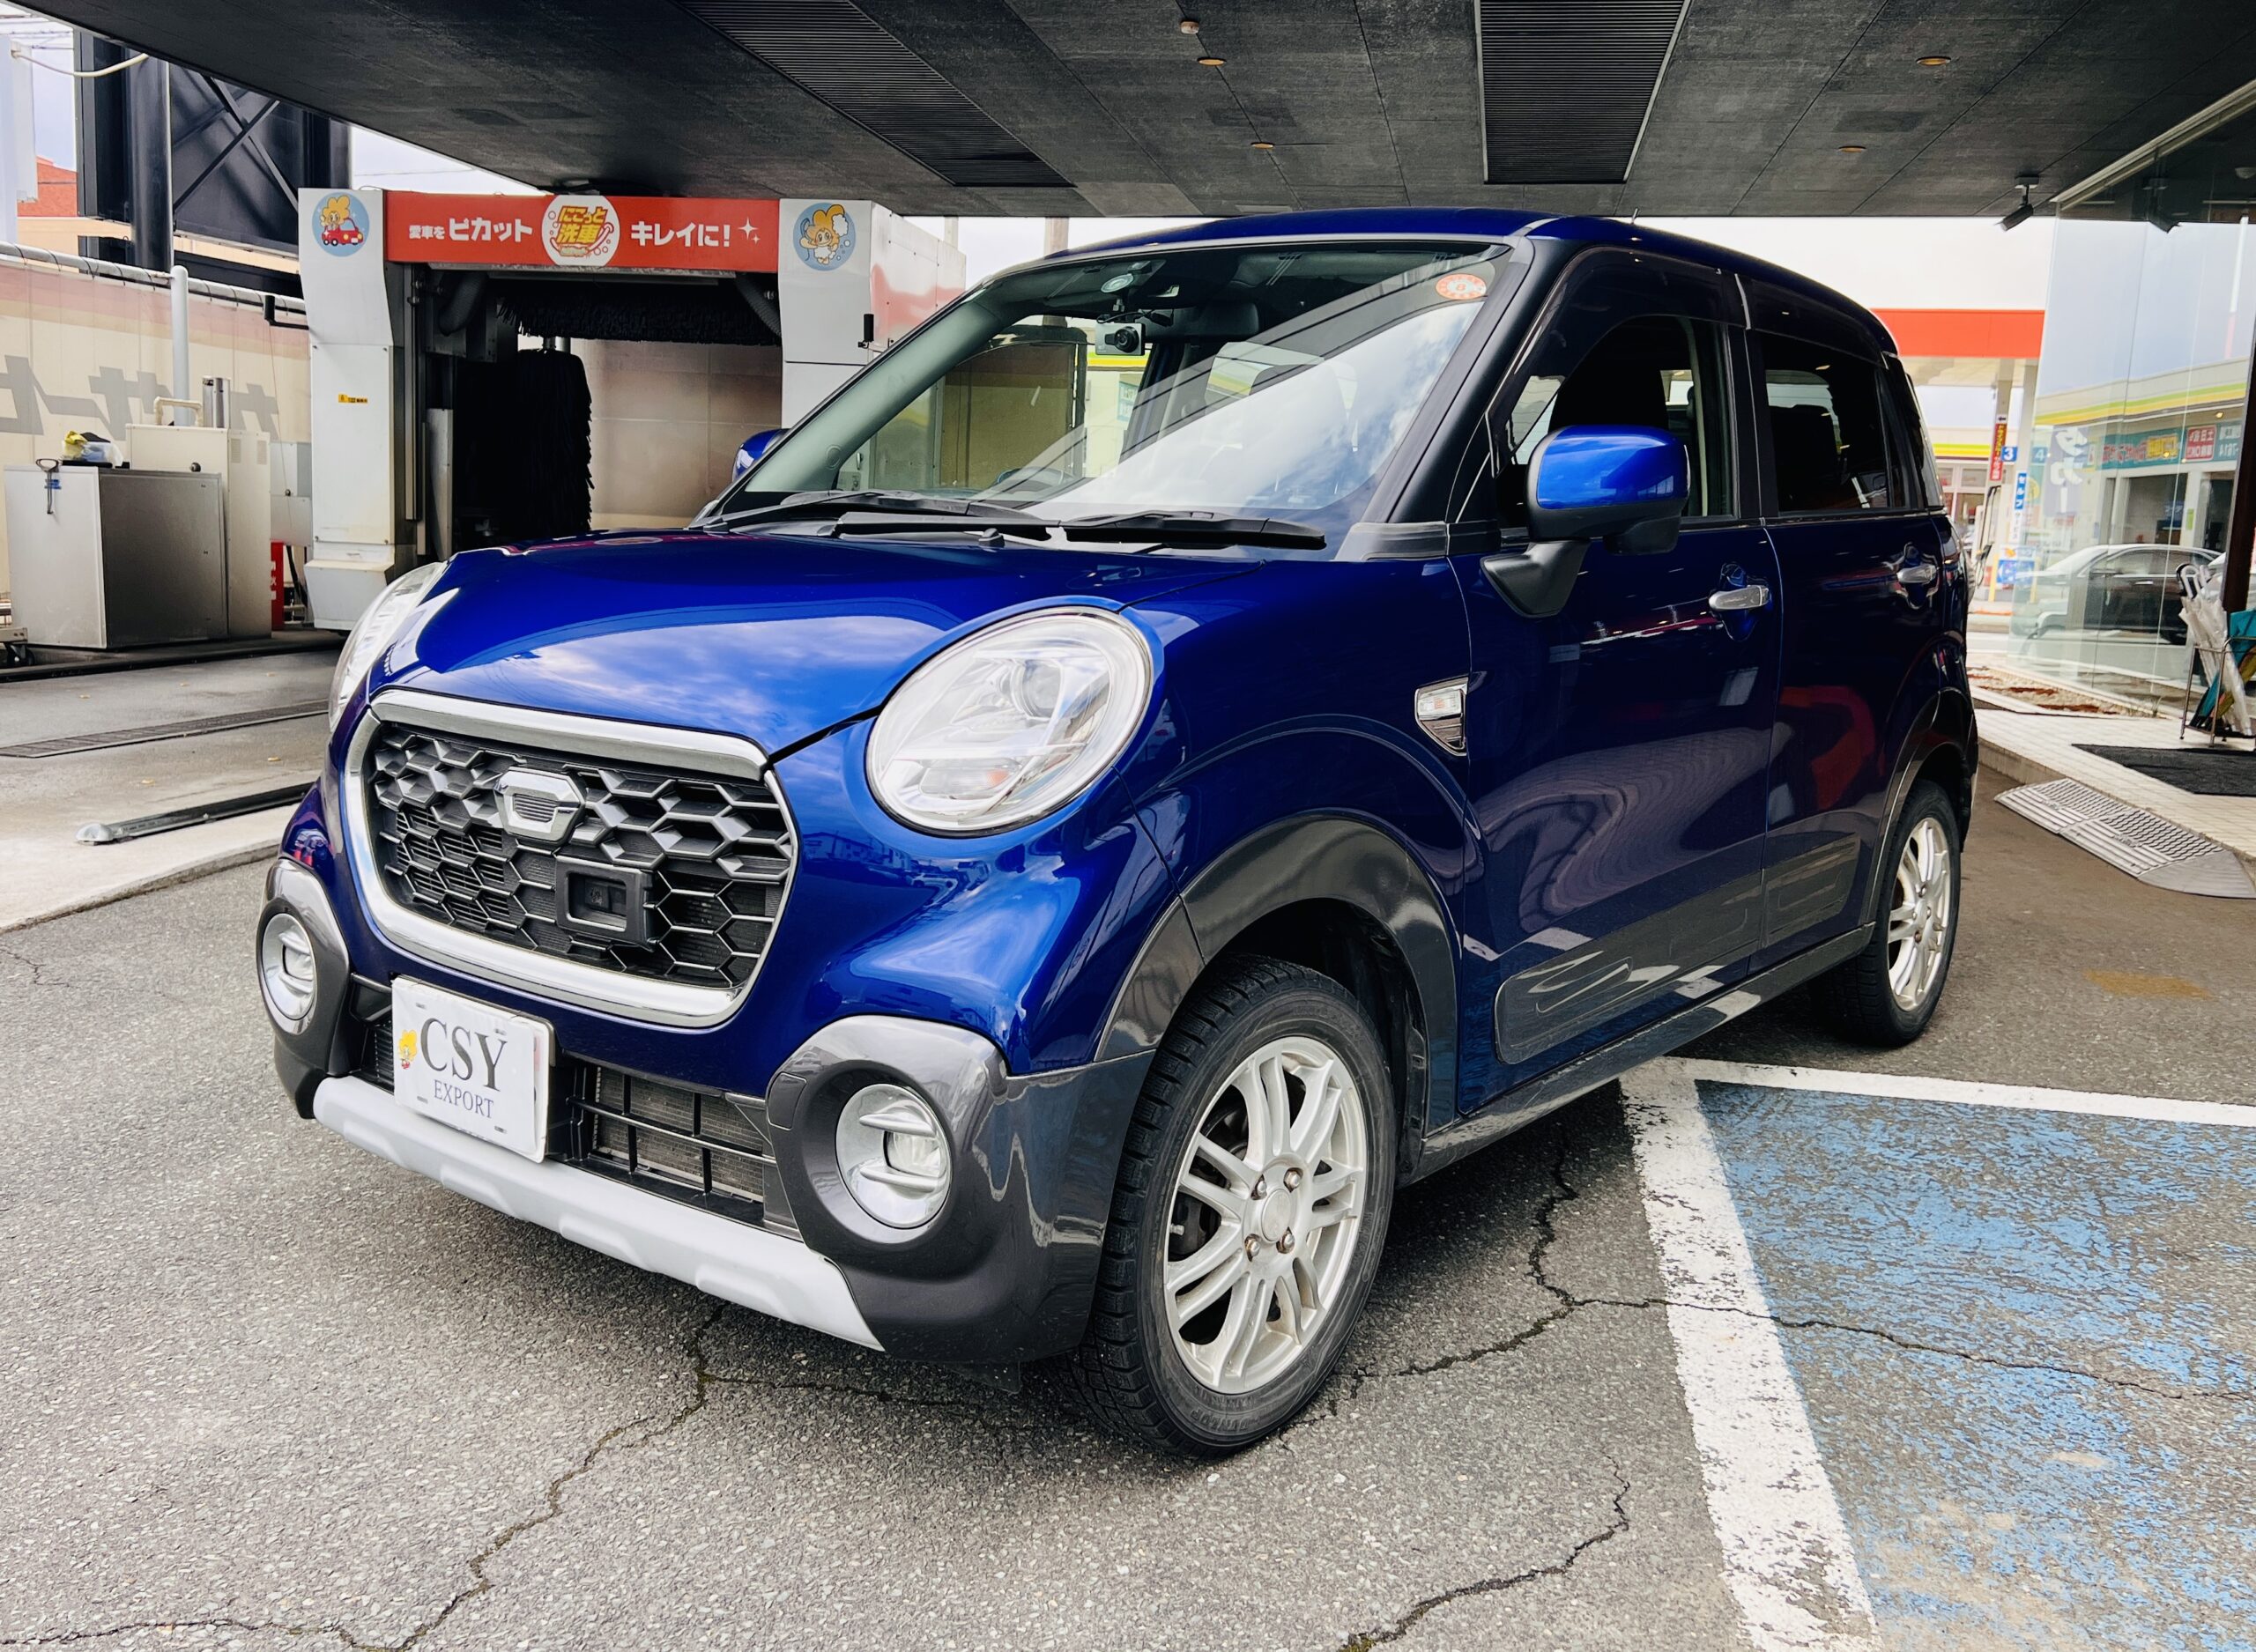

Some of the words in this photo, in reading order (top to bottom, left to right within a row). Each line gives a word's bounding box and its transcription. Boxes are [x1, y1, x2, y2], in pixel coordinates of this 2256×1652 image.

[409, 217, 532, 242] 愛車をピカット
[631, 221, 731, 248] キレイに!
[555, 223, 601, 244] 洗車
[2003, 447, 2015, 460] 3
[2035, 448, 2044, 462] 4
[420, 1018, 508, 1093] CSY
[434, 1079, 494, 1119] EXPORT
